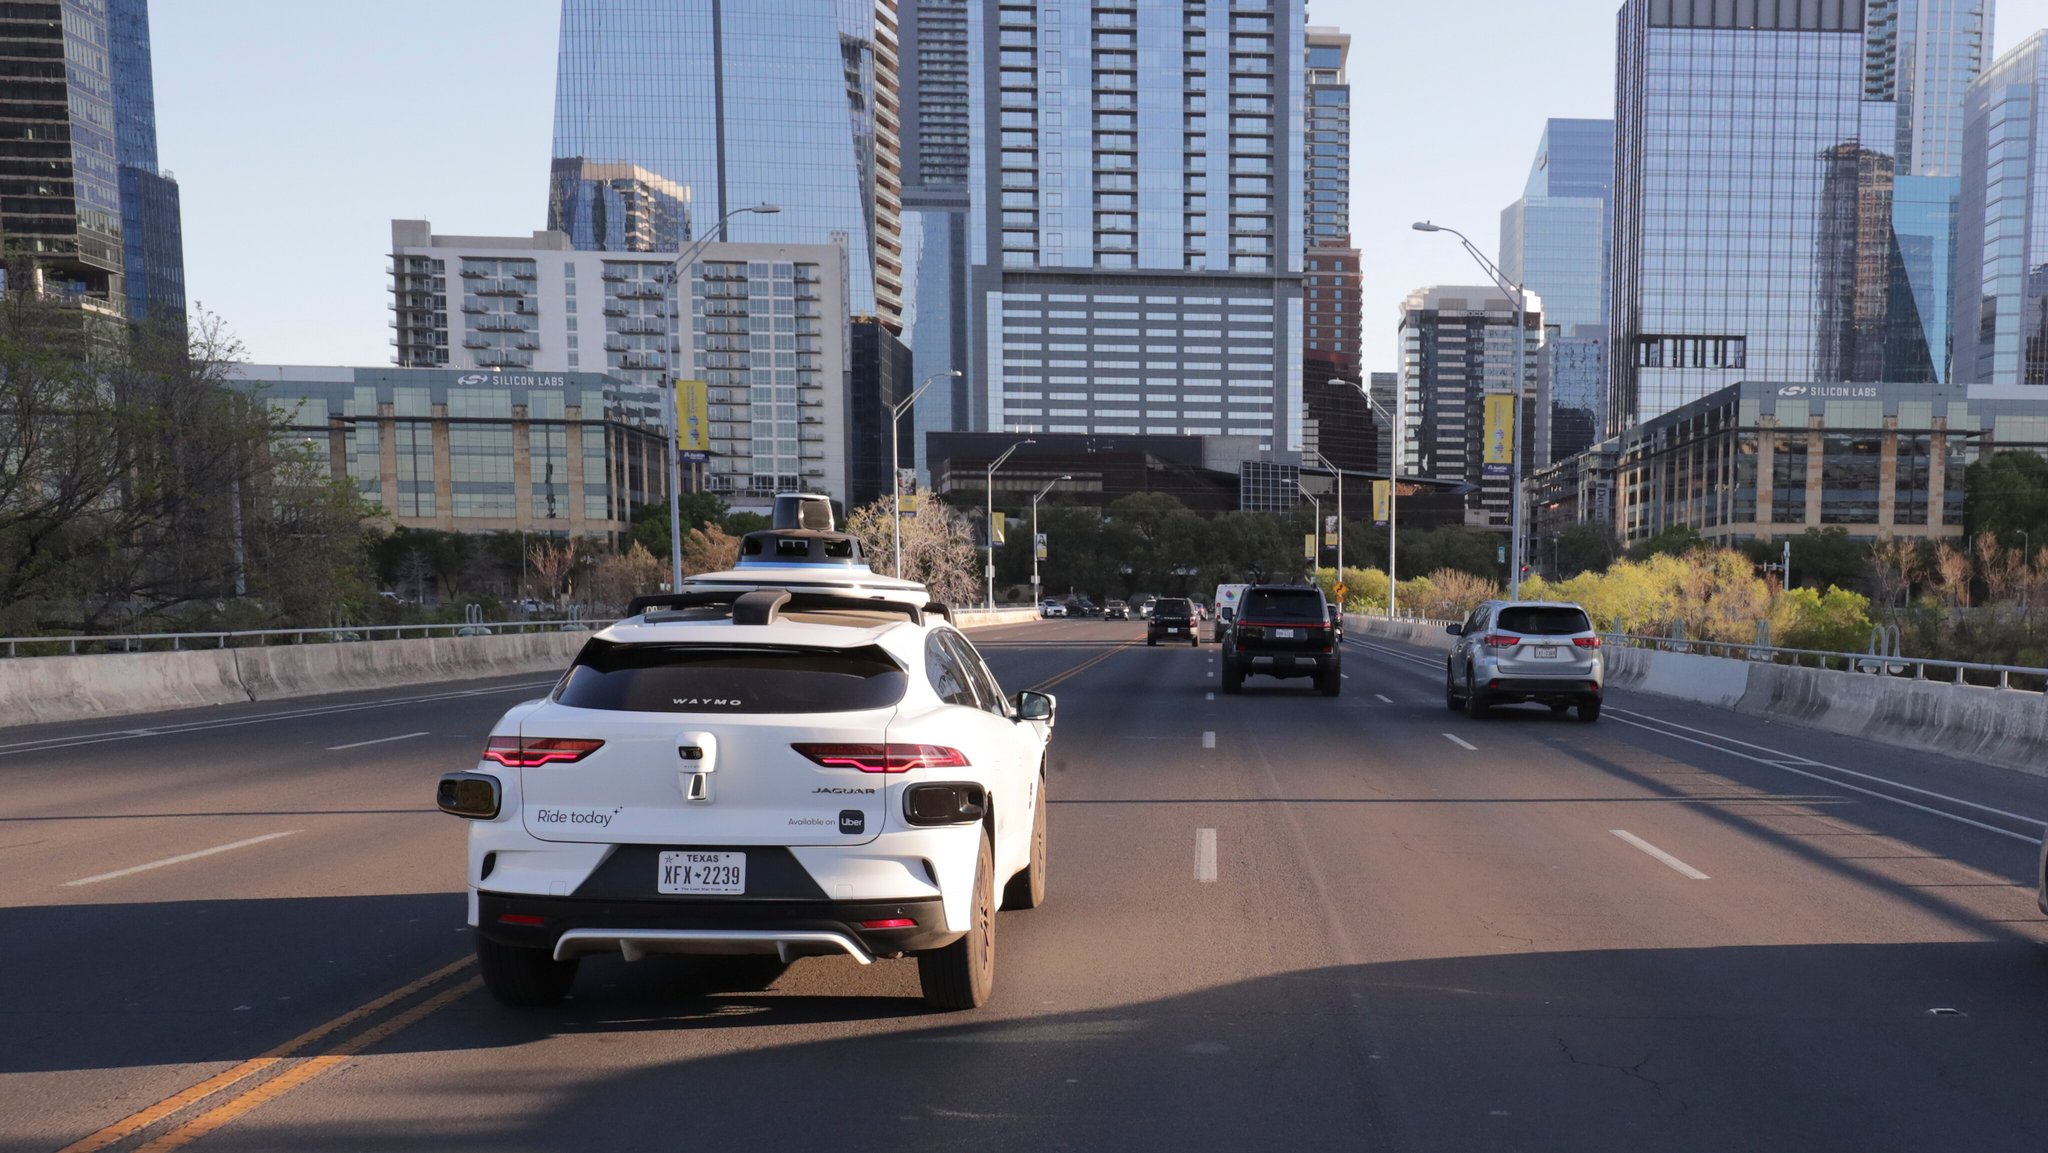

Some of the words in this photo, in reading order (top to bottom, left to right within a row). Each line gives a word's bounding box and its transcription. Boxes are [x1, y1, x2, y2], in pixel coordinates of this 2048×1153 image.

[492, 375, 534, 385] SILICON
[538, 376, 564, 387] LABS
[1810, 387, 1849, 397] SILICON
[1852, 387, 1877, 397] LABS
[672, 698, 742, 706] WAYMO
[811, 787, 876, 795] JAGUAR
[537, 809, 568, 823] Ride
[571, 810, 613, 828] today
[788, 818, 824, 826] Available
[841, 817, 863, 826] Uber
[686, 854, 720, 863] TEXAS
